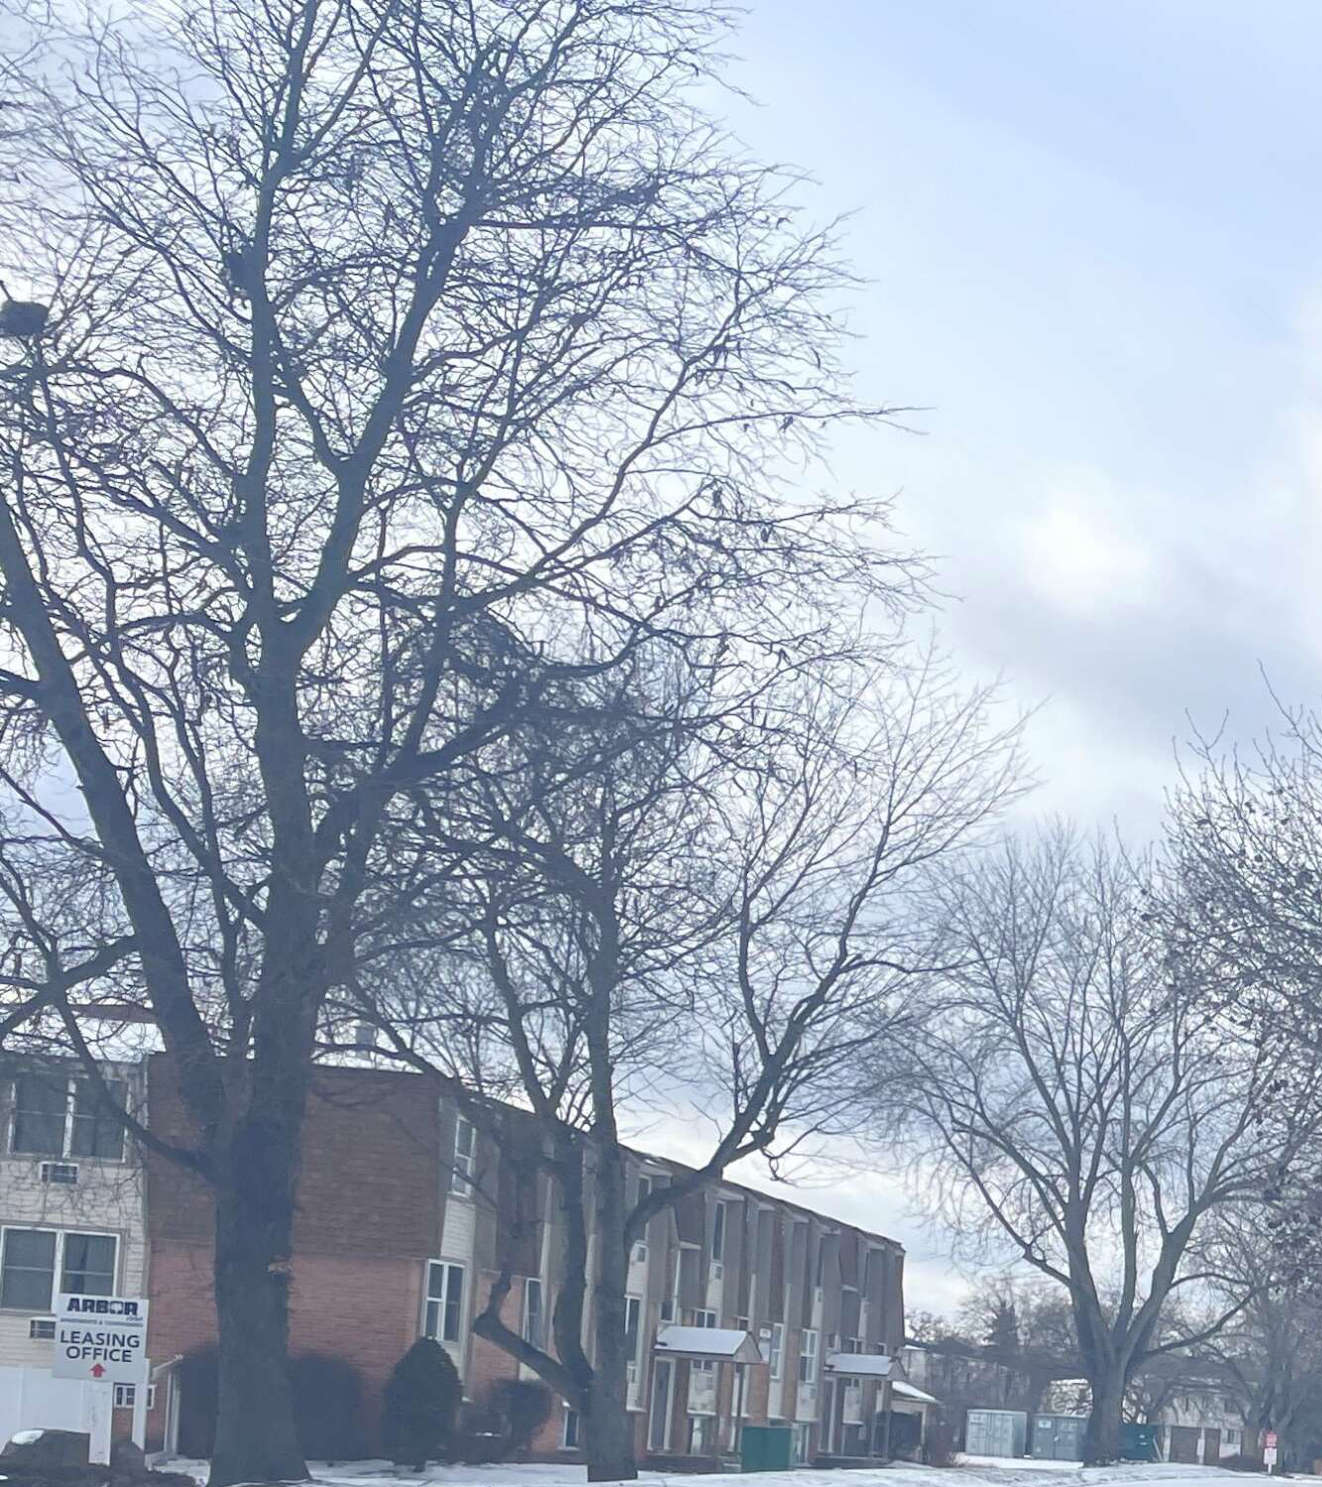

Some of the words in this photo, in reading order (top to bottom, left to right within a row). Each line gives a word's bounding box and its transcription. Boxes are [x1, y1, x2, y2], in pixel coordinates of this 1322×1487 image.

[67, 1297, 138, 1315] ARBOR
[60, 1330, 140, 1348] LEASING
[66, 1345, 132, 1363] OFFICE
